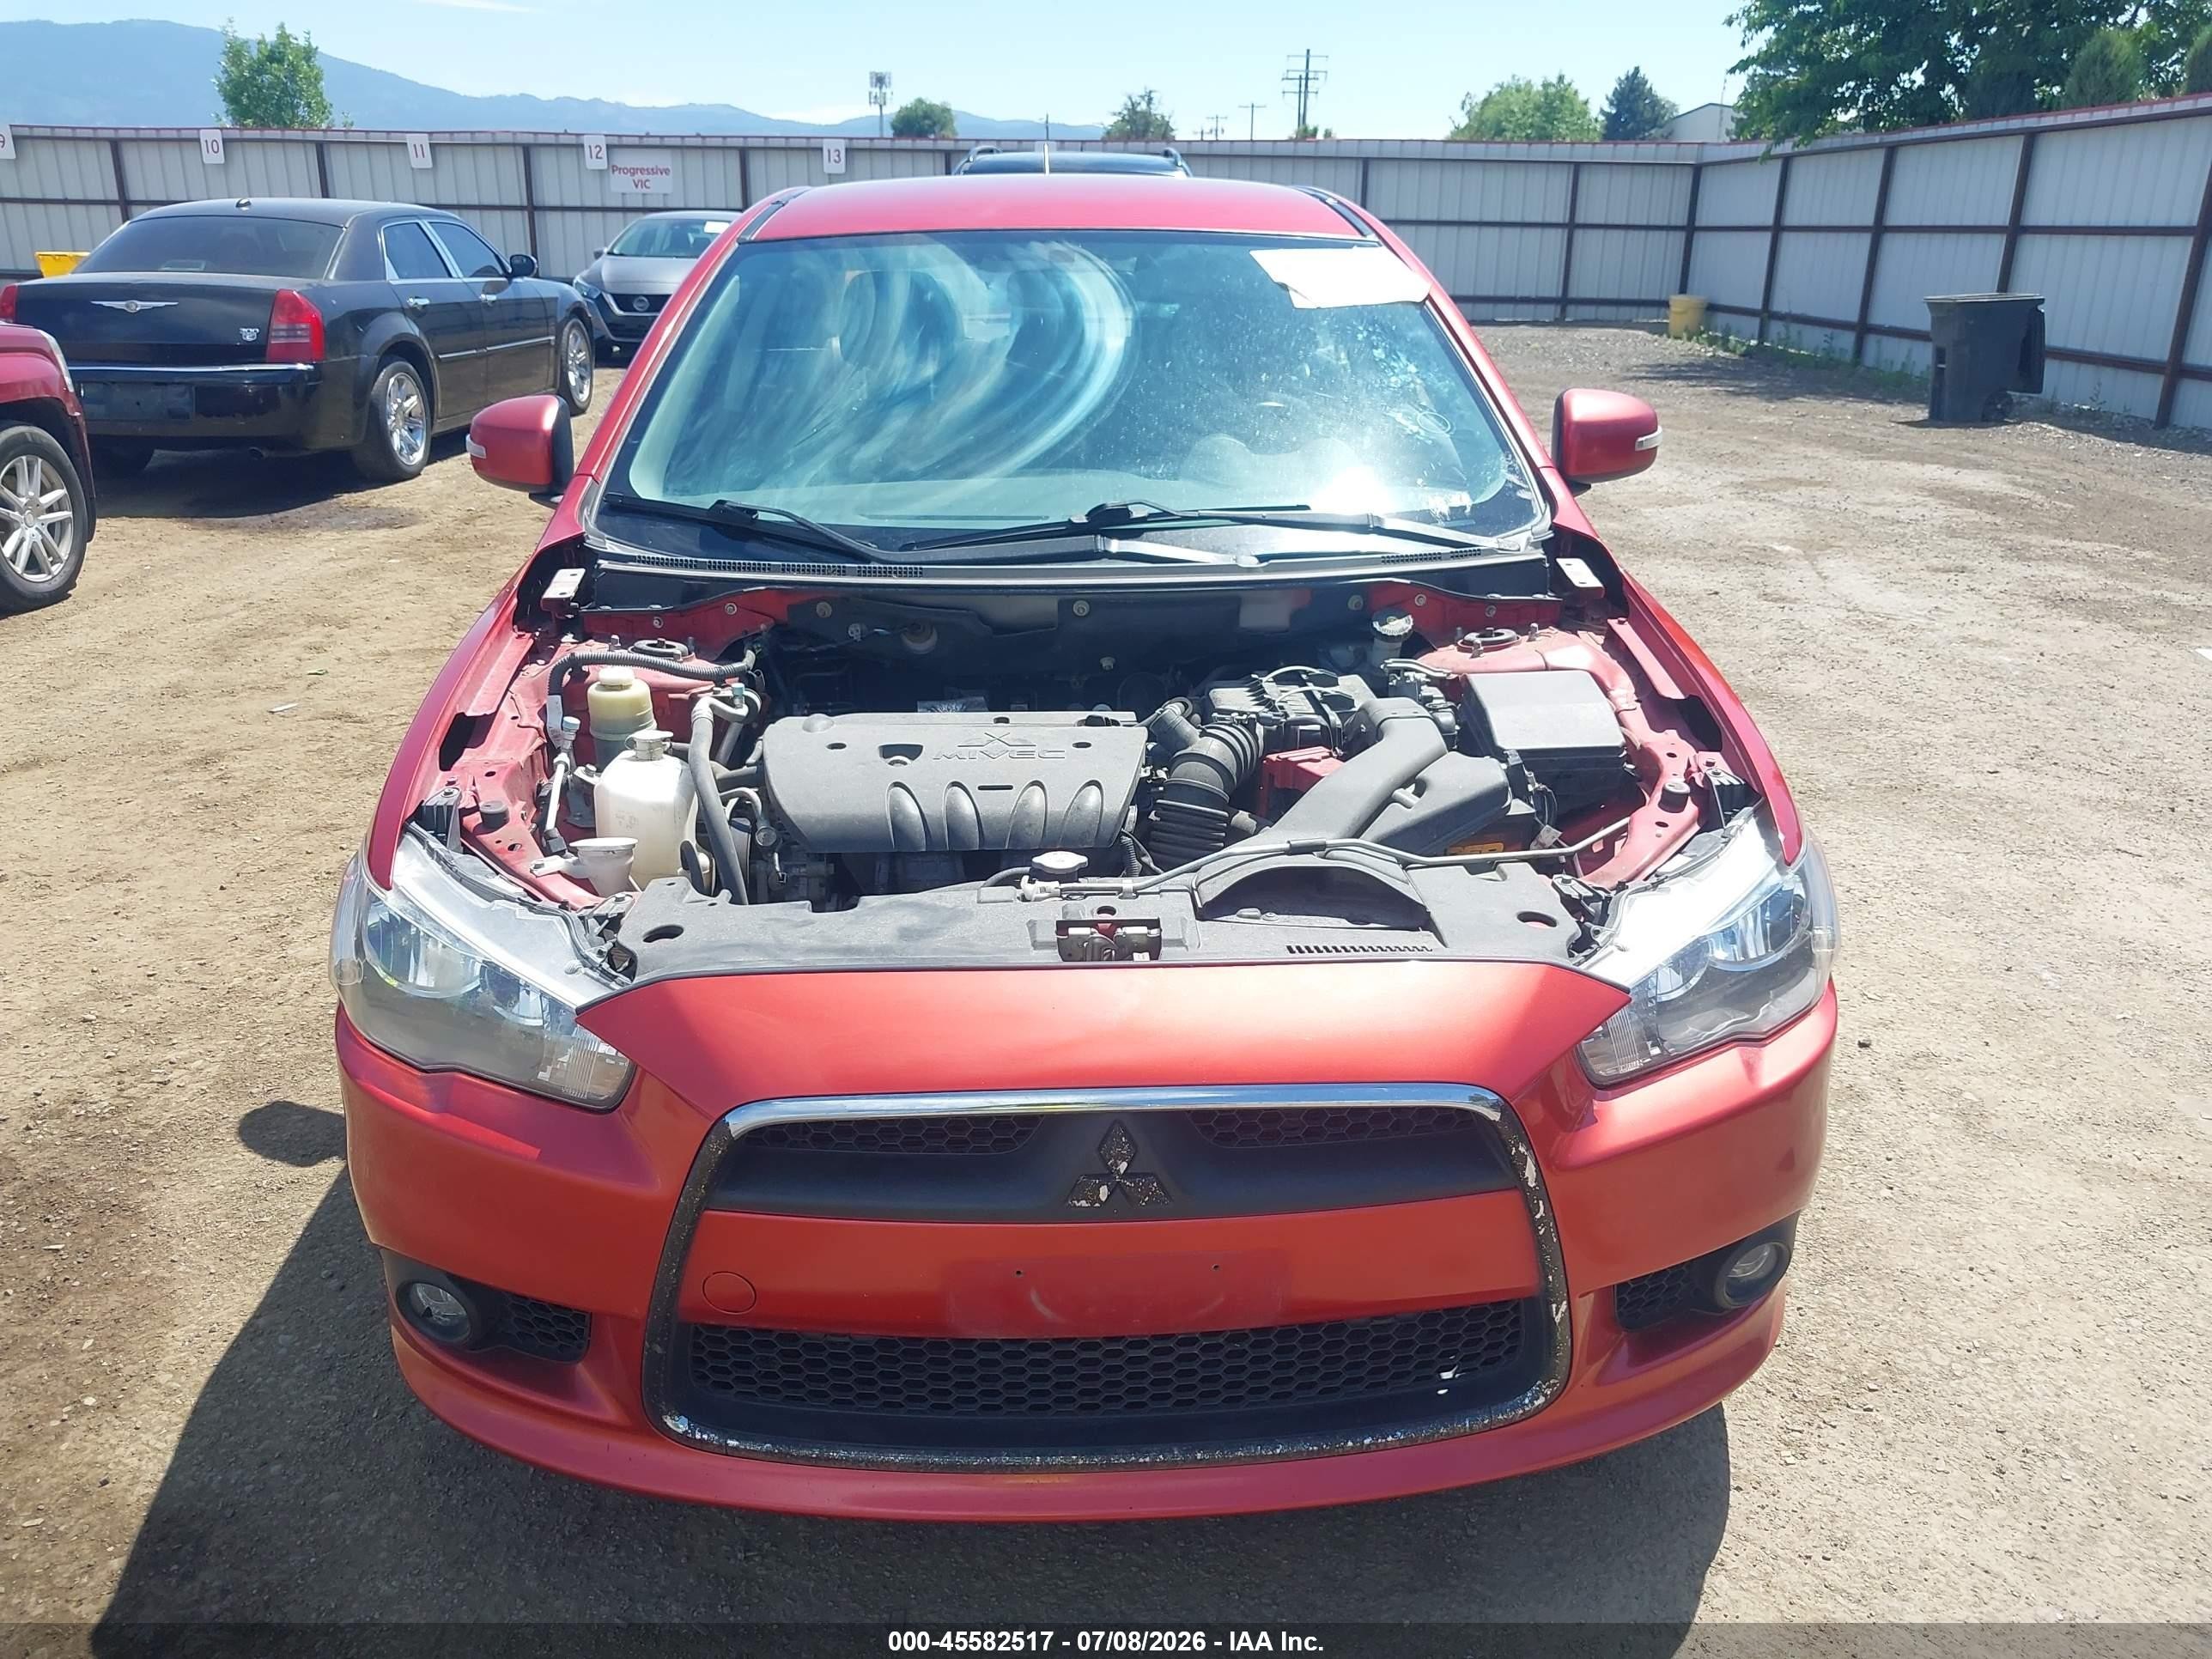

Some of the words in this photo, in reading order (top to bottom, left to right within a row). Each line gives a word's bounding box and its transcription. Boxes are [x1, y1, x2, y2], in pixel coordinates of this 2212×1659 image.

[205, 139, 220, 154] 10
[413, 143, 425, 159] 11
[588, 144, 604, 160] 12
[828, 149, 842, 163] 13
[611, 164, 671, 177] Progressive
[632, 179, 651, 189] VIC
[933, 750, 1066, 761] MIVEC
